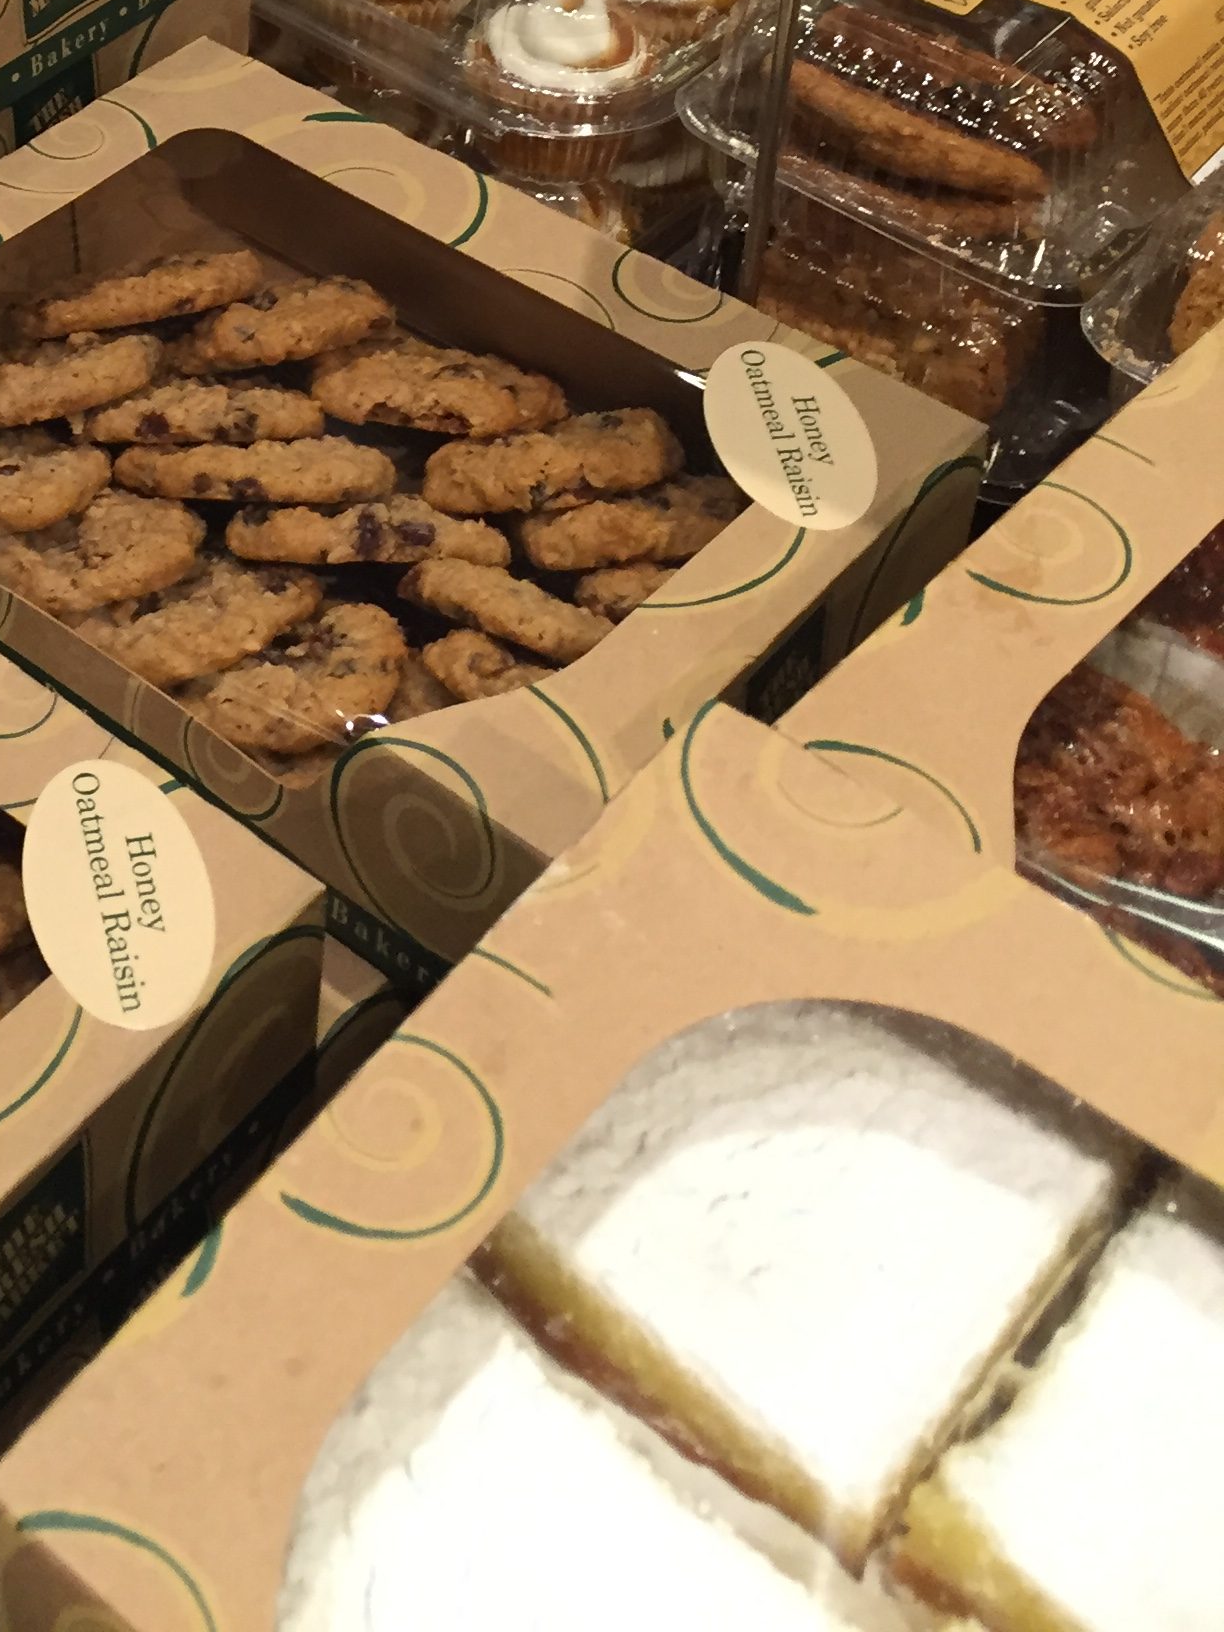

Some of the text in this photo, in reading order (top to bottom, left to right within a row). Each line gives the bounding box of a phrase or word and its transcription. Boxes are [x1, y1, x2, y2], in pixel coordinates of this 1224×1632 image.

[30, 17, 111, 78] Bakery
[740, 349, 821, 518] Oatmeal Raisin
[791, 396, 835, 466] Honey
[72, 772, 146, 1013] Oatmeal Raisin
[125, 832, 166, 933] Honey
[331, 897, 430, 983] Baker
